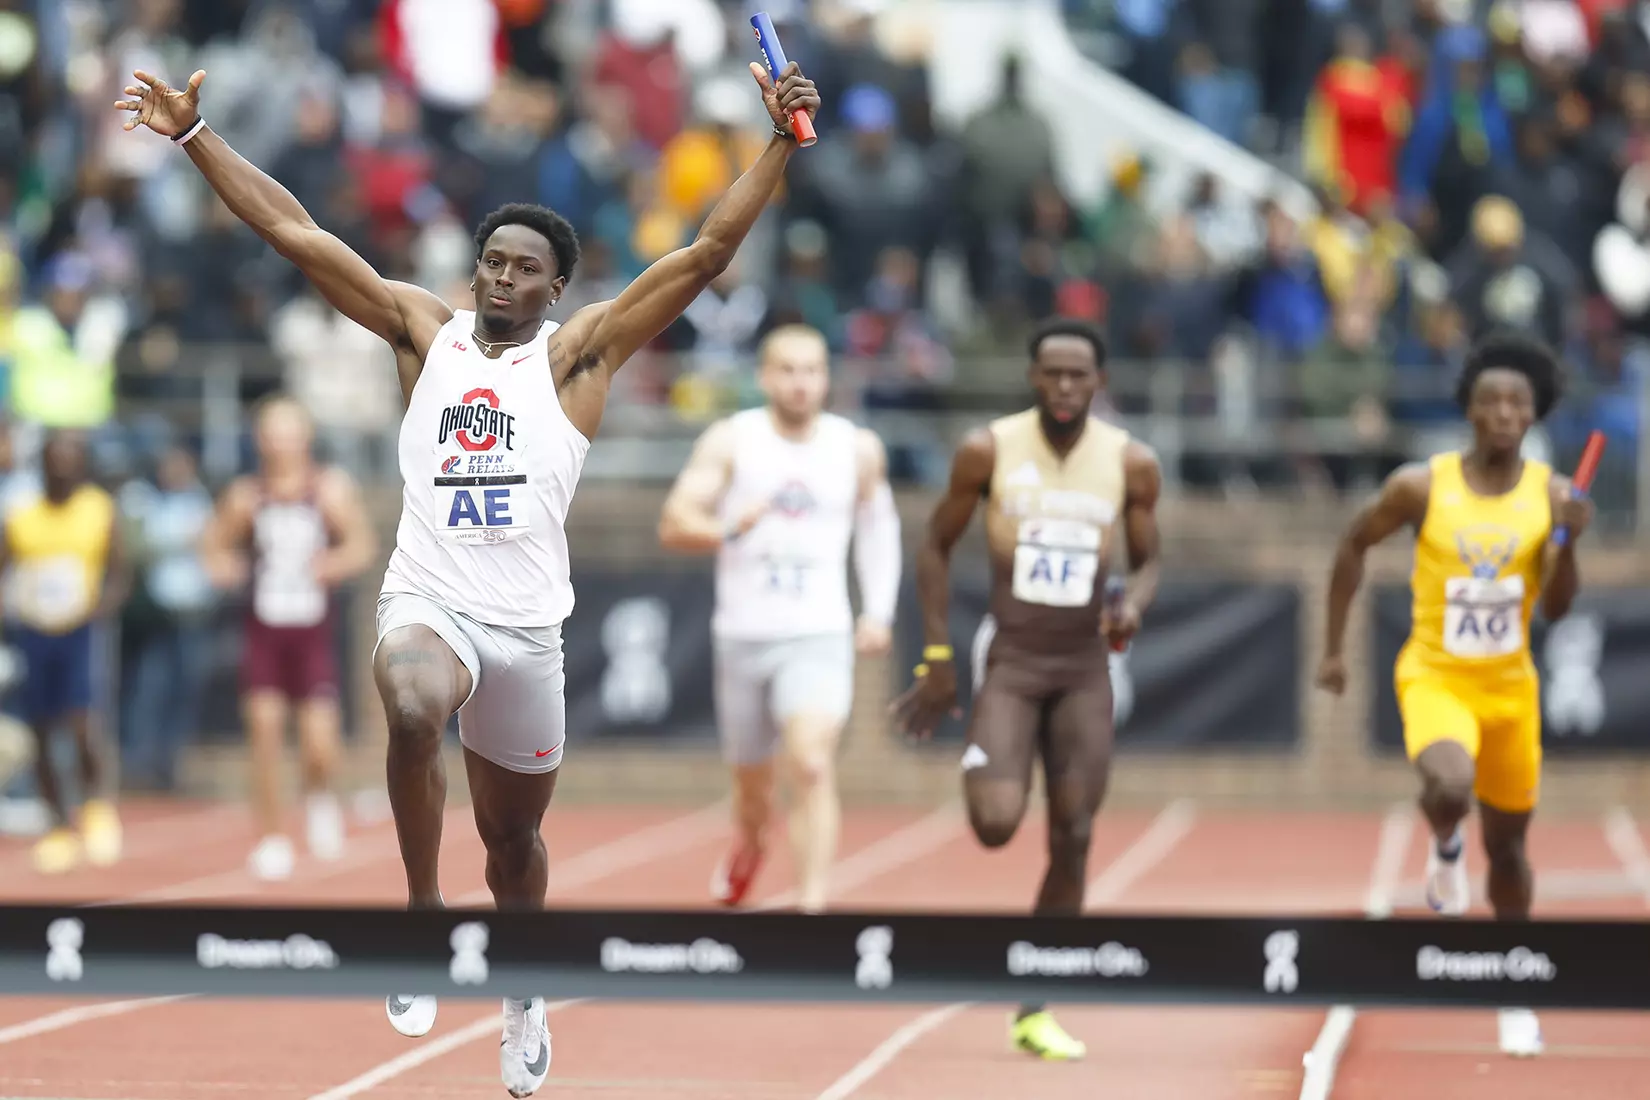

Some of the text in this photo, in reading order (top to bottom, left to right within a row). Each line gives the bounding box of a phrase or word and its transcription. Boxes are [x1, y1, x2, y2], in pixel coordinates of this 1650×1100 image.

[438, 403, 516, 451] OHIO STATE
[467, 464, 515, 474] RELAYS
[468, 455, 504, 465] PENN
[447, 489, 513, 526] AE
[455, 532, 482, 540] AMERICA
[1028, 557, 1080, 584] AF
